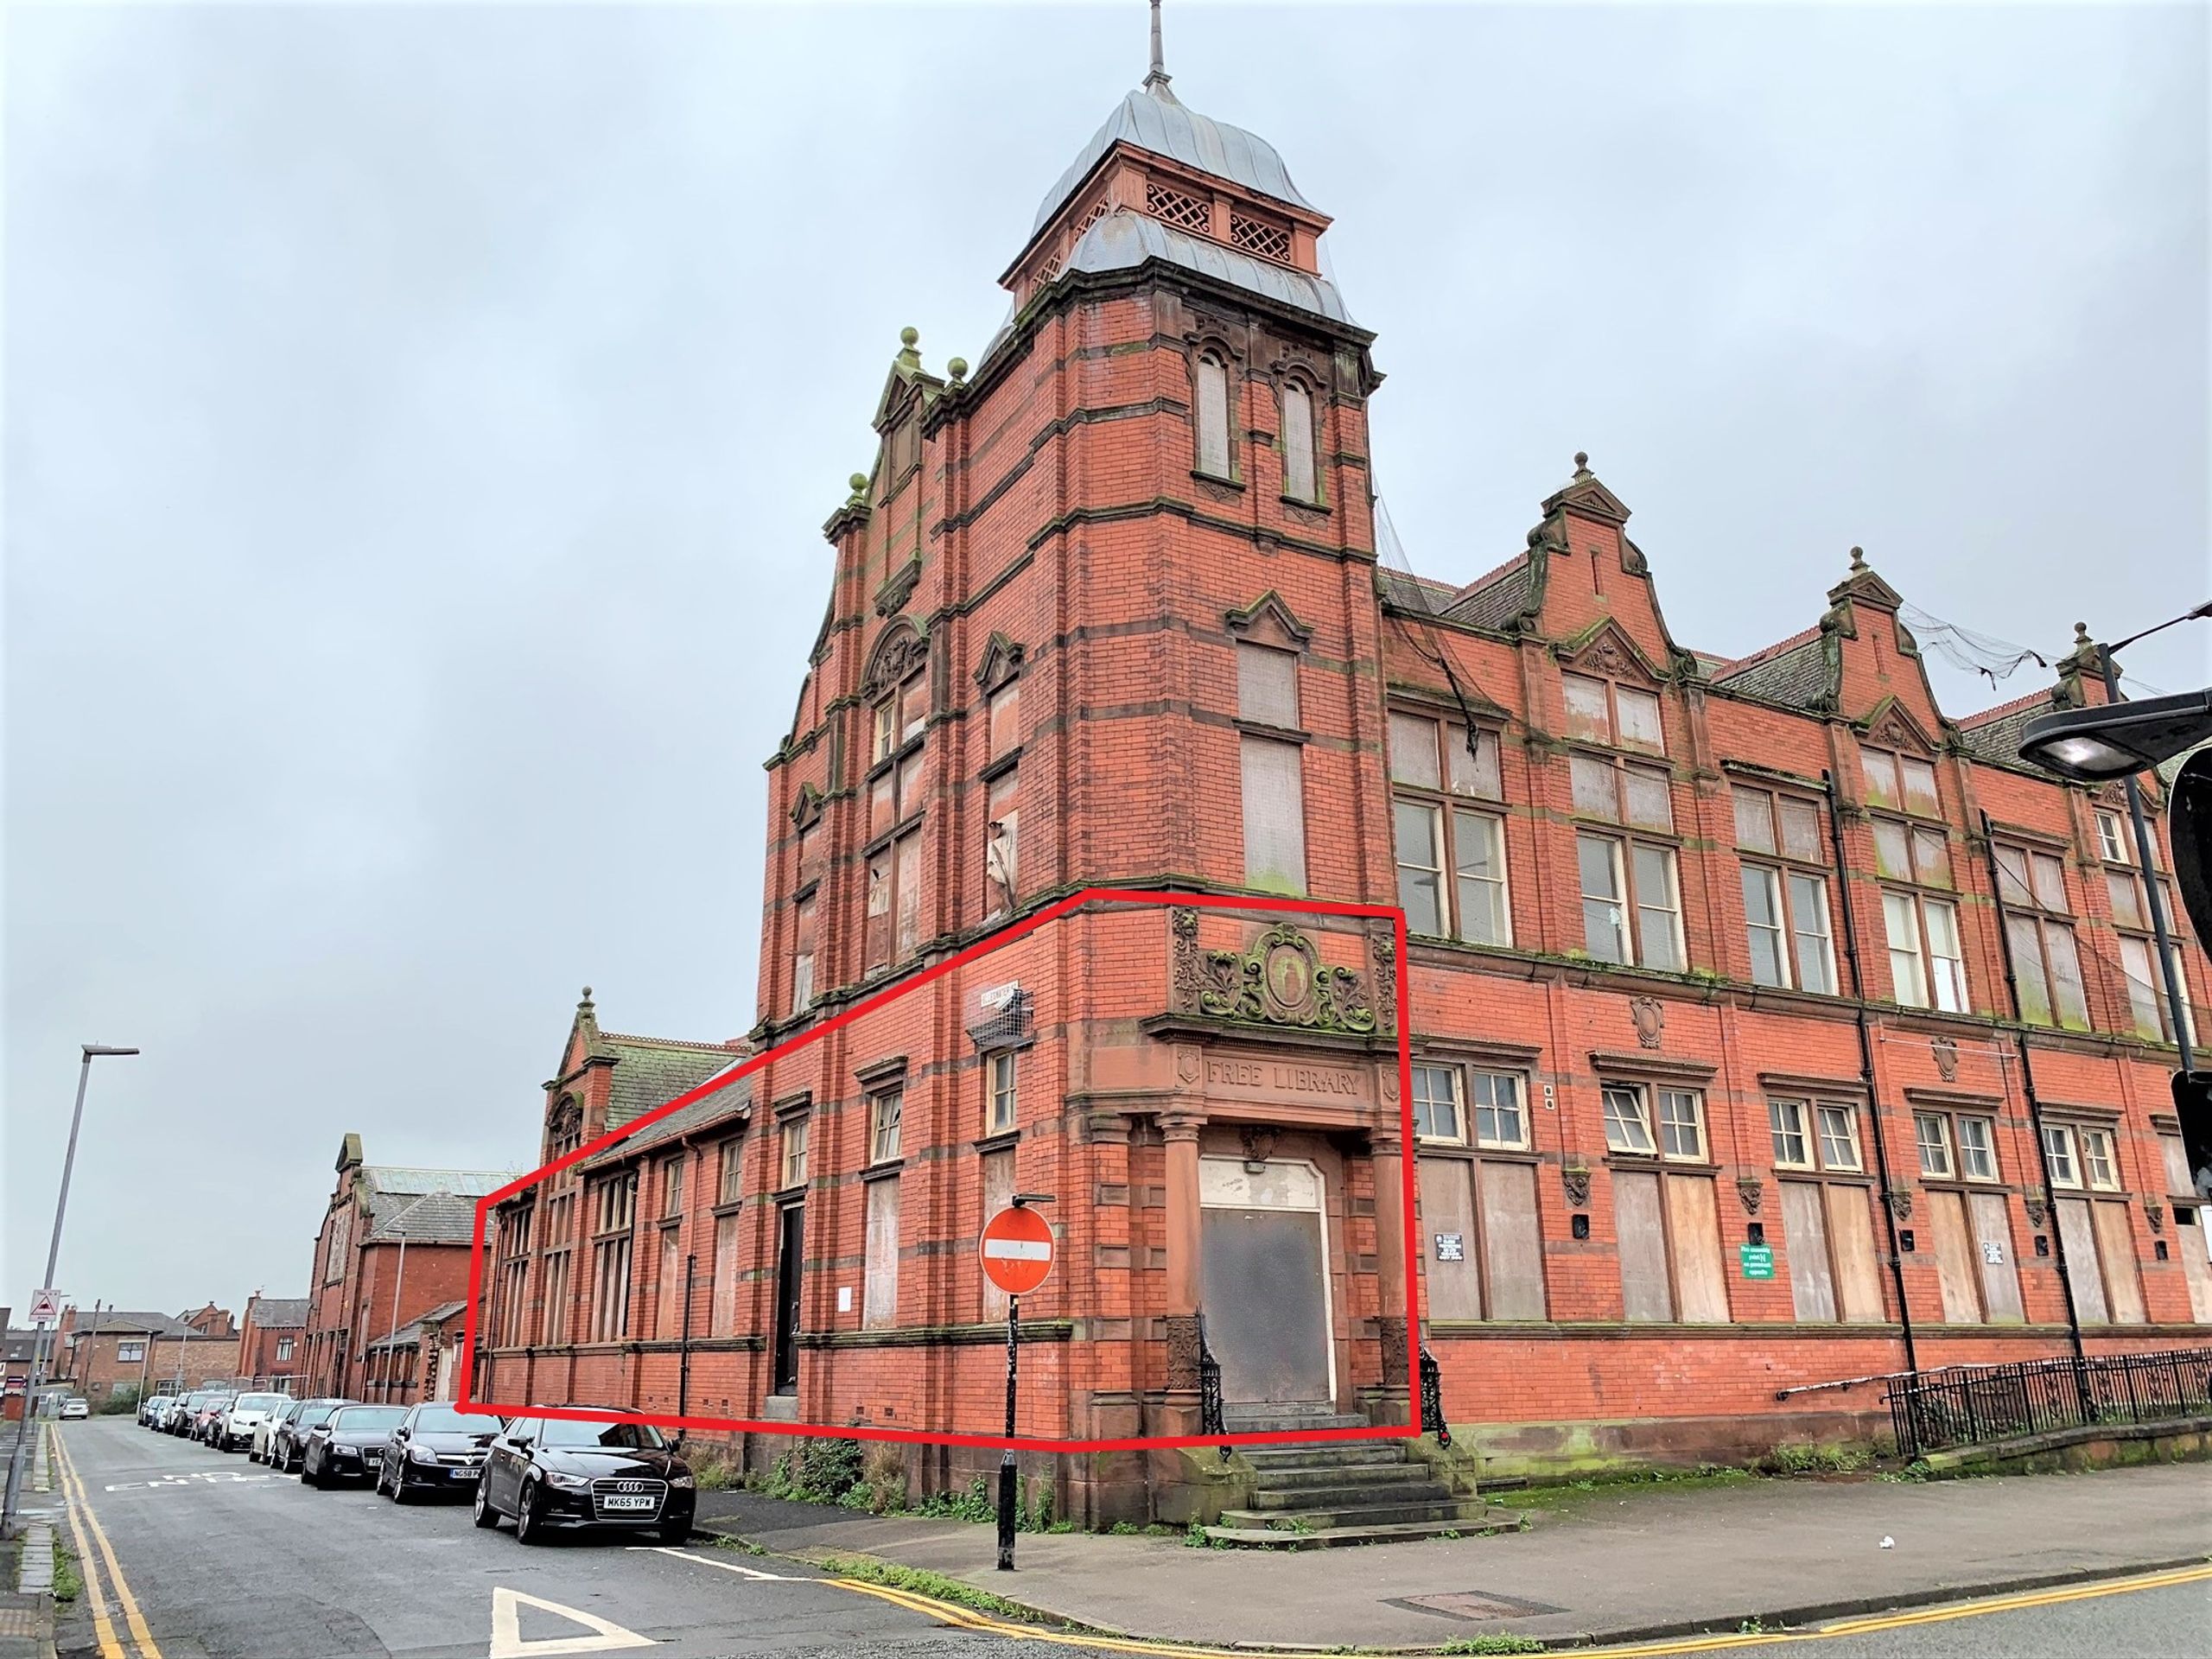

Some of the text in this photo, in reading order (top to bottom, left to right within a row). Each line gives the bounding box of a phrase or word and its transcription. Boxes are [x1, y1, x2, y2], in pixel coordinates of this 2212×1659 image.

[1207, 1061, 1362, 1096] FREE LIBRARY
[105, 1471, 302, 1492] ENTRY
[607, 1497, 632, 1507] MK65
